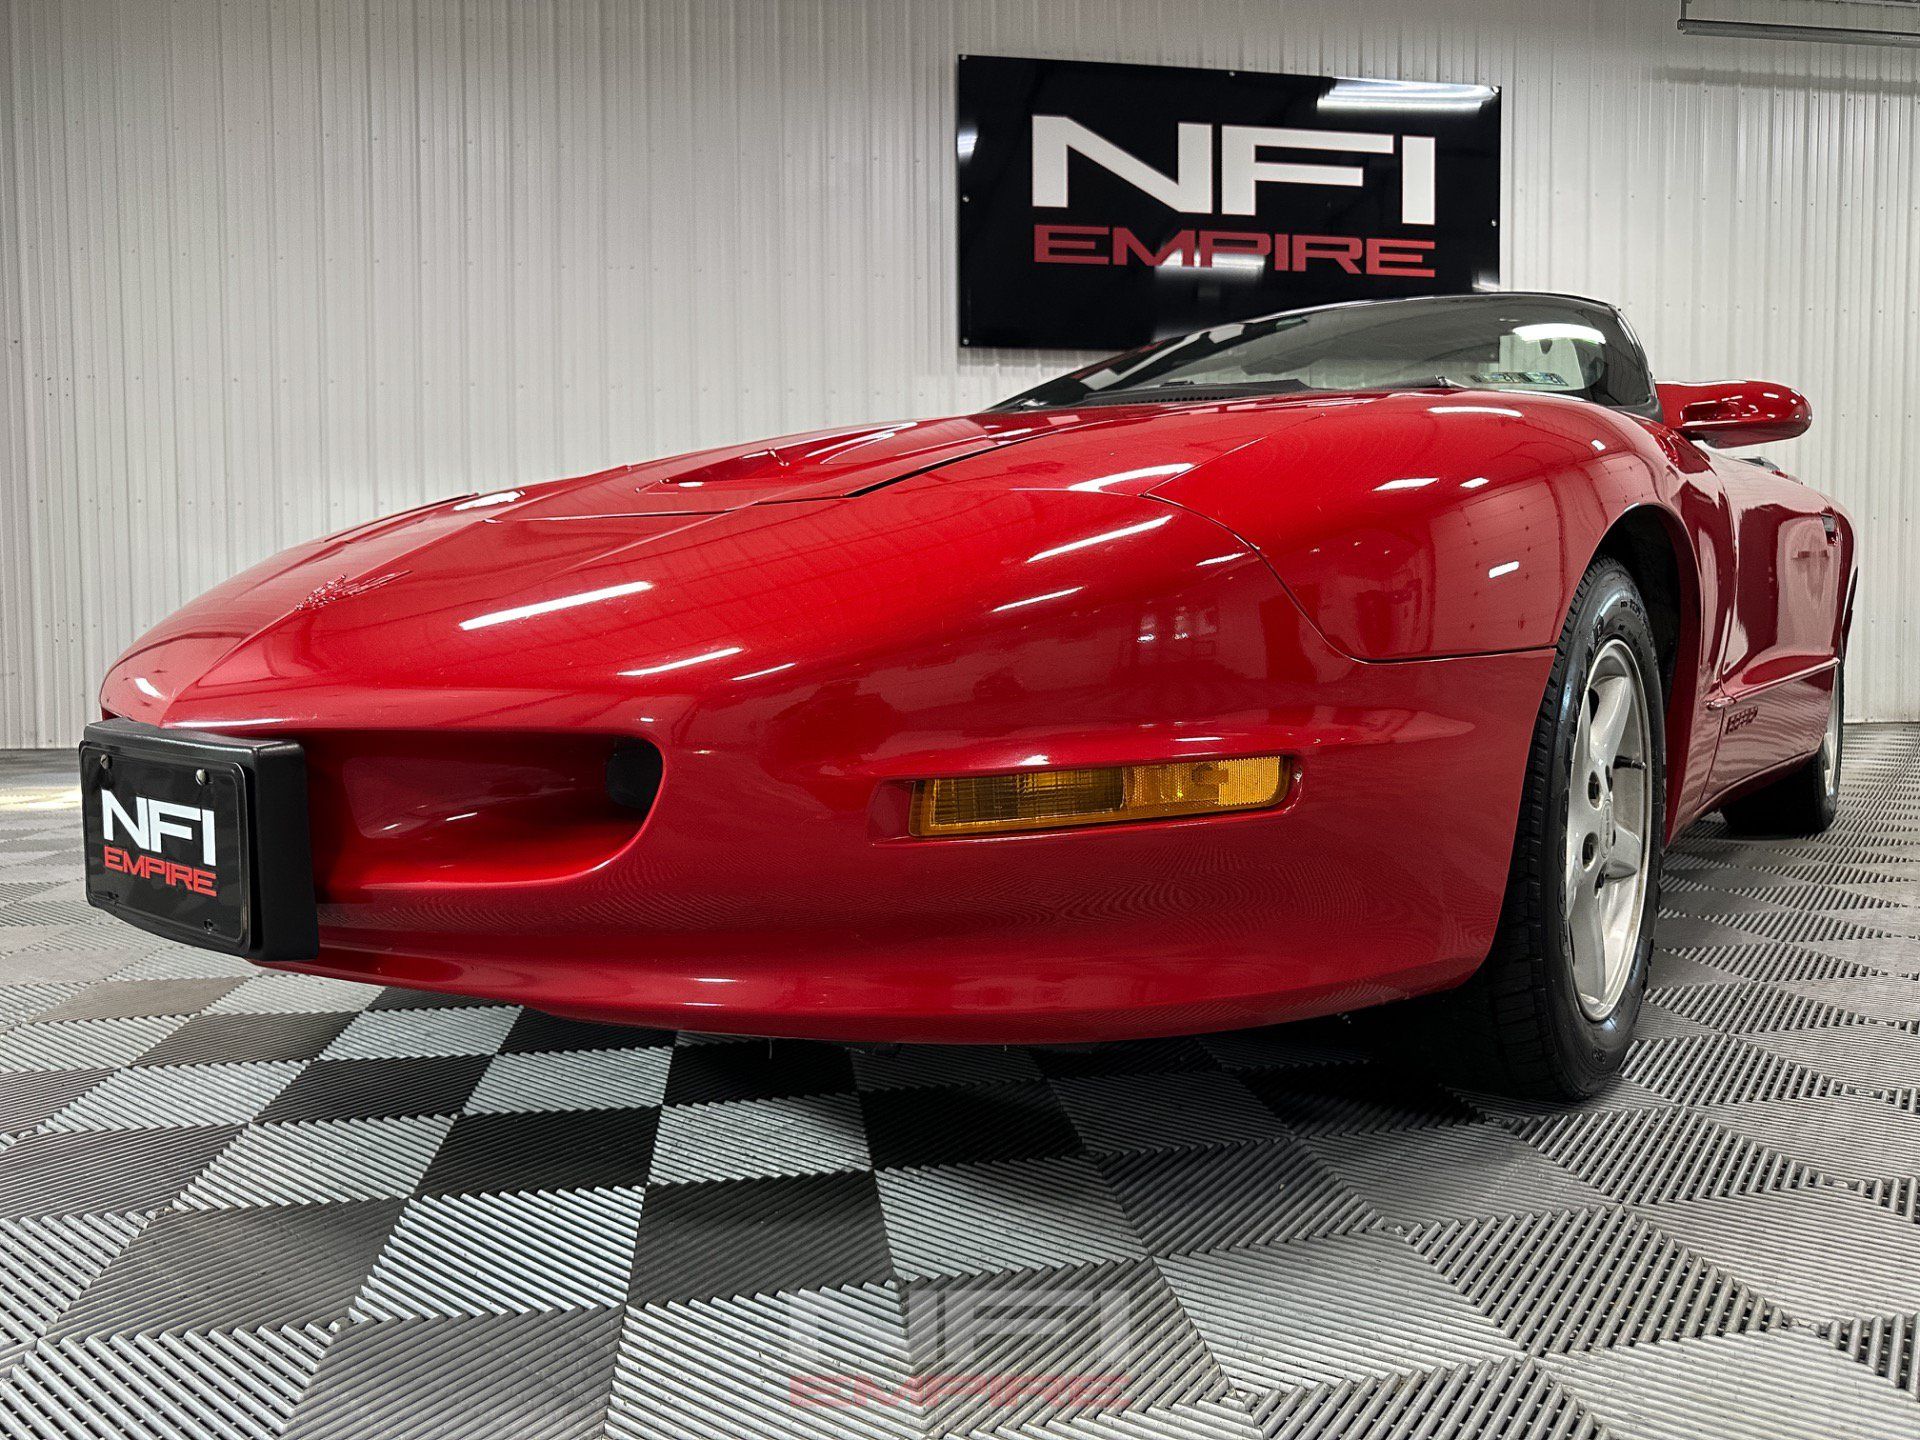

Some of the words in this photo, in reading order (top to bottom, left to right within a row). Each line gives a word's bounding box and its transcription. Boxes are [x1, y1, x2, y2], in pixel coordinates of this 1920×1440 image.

[1031, 114, 1436, 226] NFI
[1033, 224, 1436, 278] EMPIRE
[101, 788, 217, 867] NFI
[103, 845, 218, 898] EMPIRE
